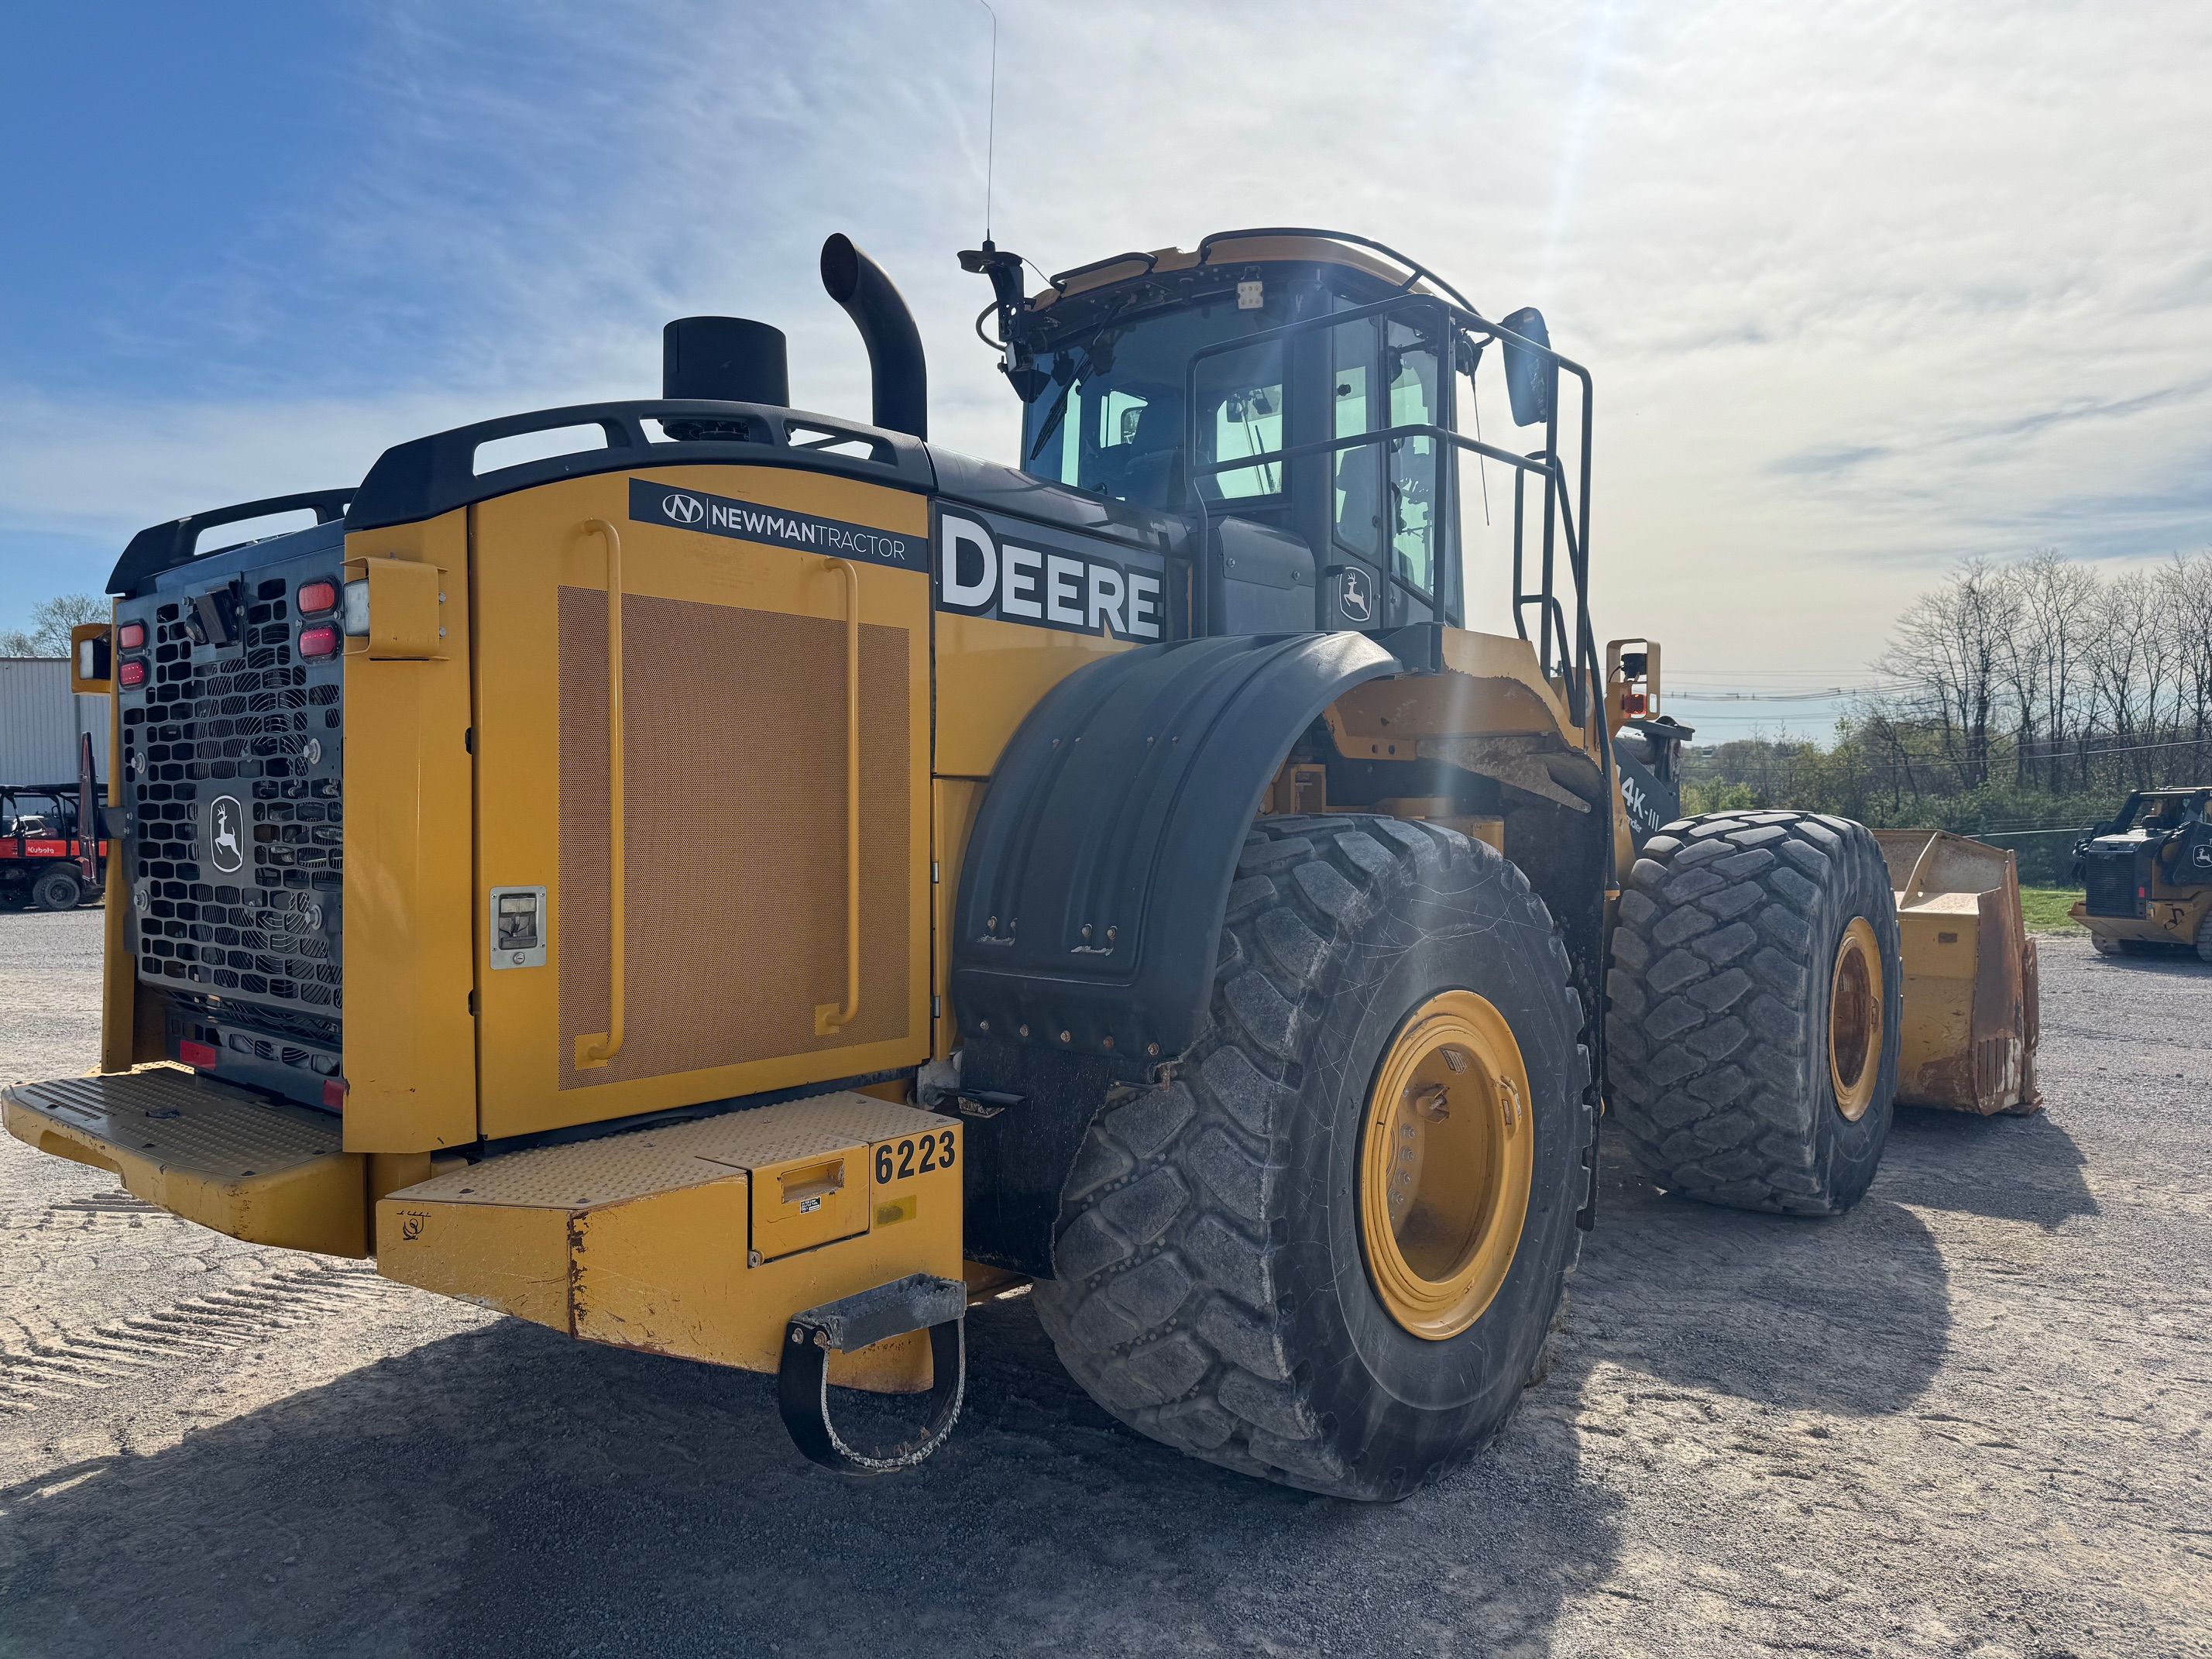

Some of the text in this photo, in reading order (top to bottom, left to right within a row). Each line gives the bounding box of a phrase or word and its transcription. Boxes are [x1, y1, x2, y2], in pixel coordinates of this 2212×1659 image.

[942, 514, 1159, 638] DEERE
[1616, 764, 1659, 833] 4K-III
[875, 1131, 955, 1184] 6223
